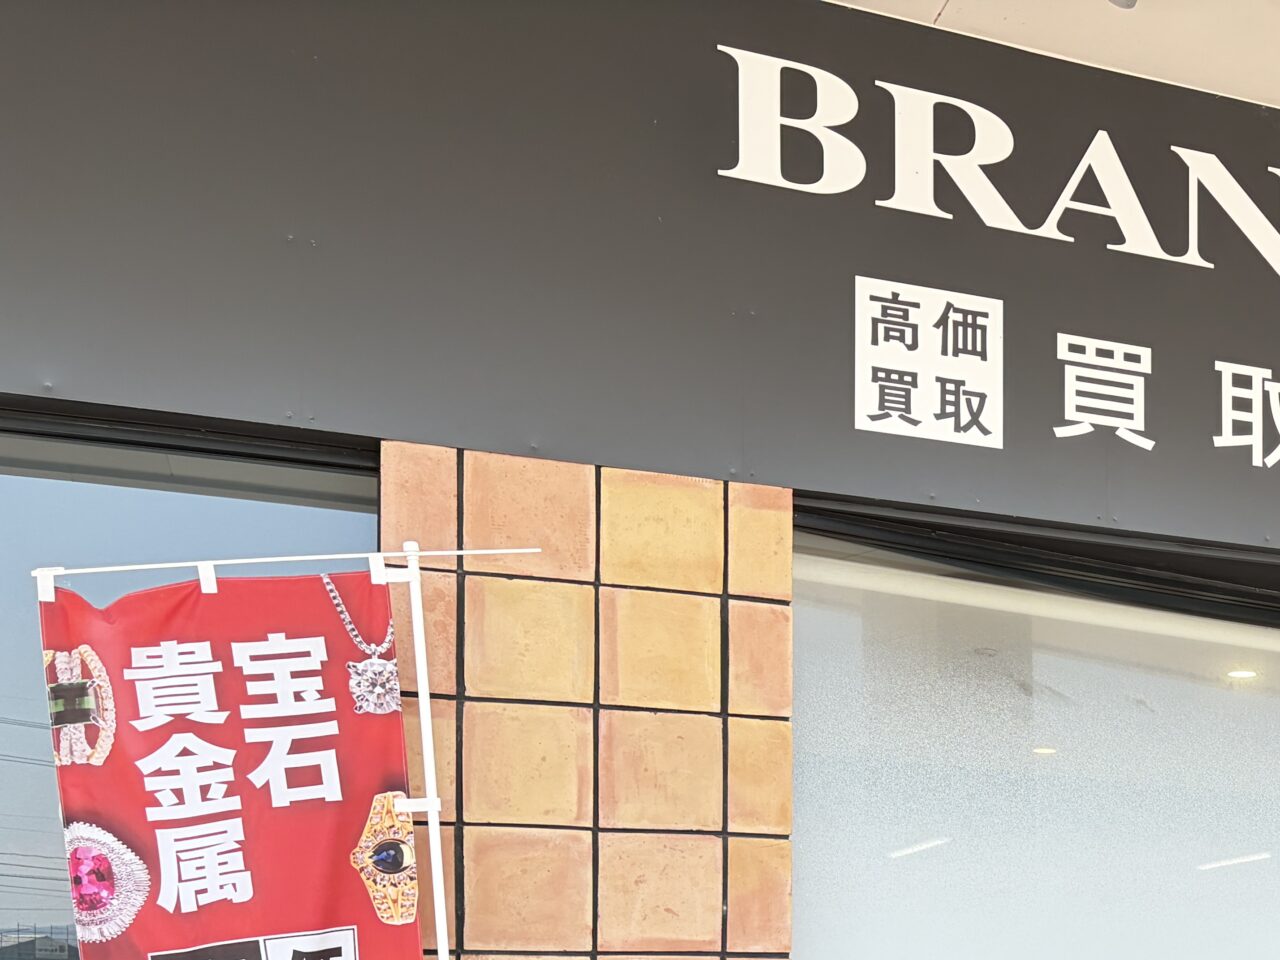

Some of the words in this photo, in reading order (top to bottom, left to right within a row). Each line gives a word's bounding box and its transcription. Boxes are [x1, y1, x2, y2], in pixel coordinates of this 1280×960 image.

[869, 291, 989, 362] 高価
[866, 365, 992, 437] 買取
[123, 640, 254, 914] 貴金属
[231, 632, 343, 808] 宝石
